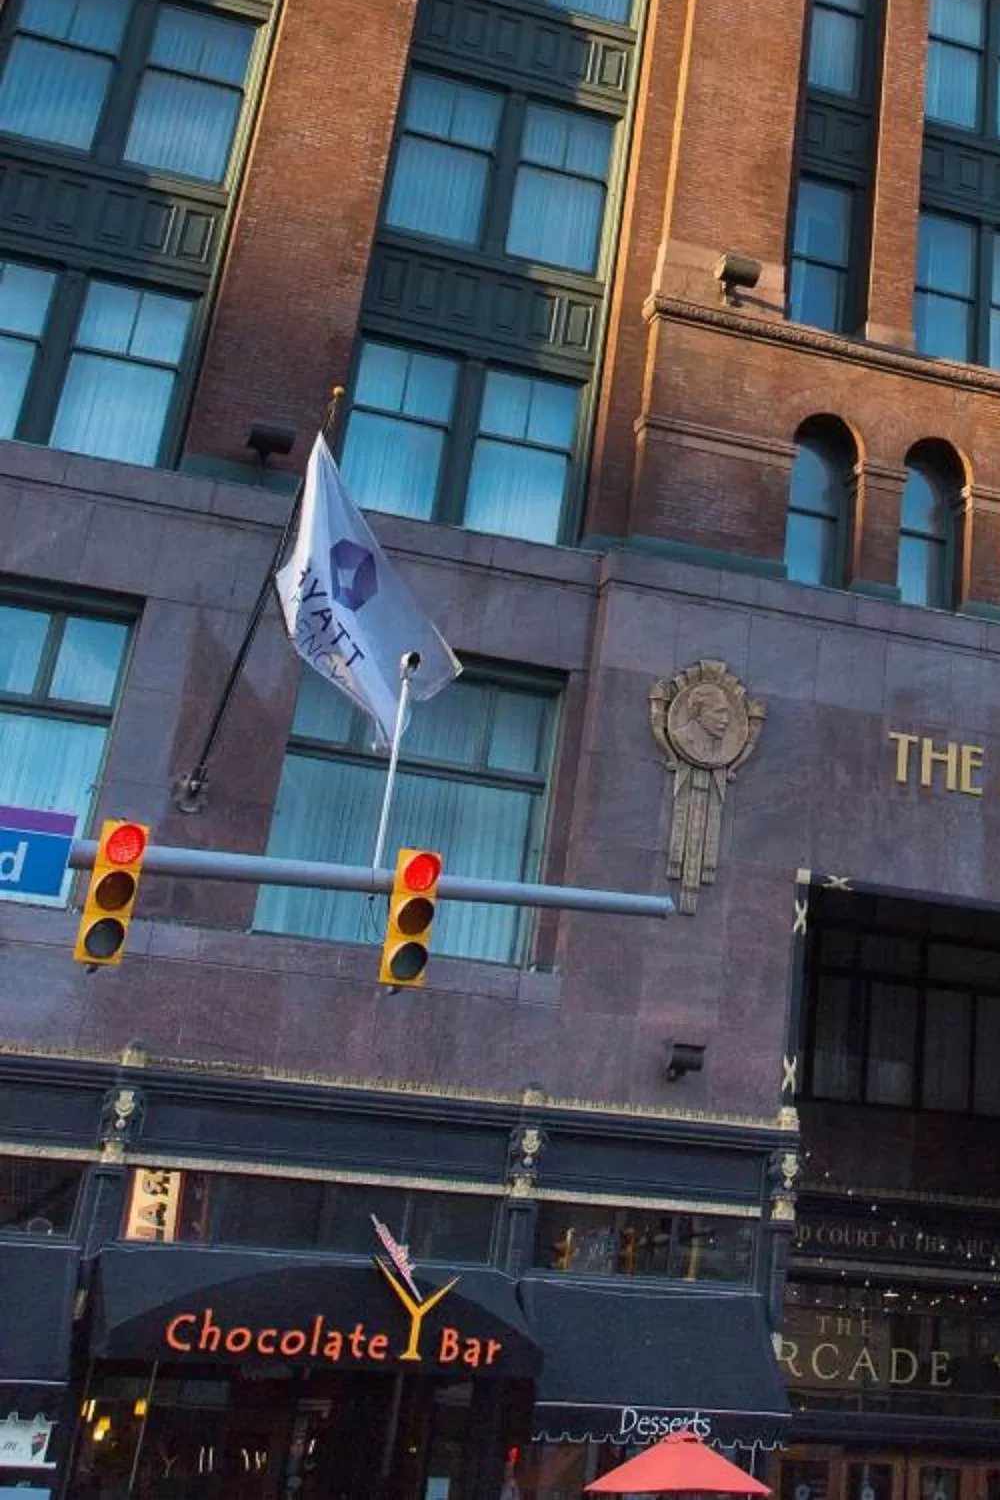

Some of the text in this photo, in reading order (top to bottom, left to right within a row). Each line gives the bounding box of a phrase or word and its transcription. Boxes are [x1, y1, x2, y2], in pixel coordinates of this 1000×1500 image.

[888, 731, 984, 797] THE
[816, 1224, 881, 1248] COURT
[885, 1234, 906, 1250] AT
[166, 1308, 502, 1367] Chocolate Bar
[815, 1315, 873, 1337] THE
[774, 1341, 953, 1387] RCADE
[620, 1407, 711, 1437] Desserts
